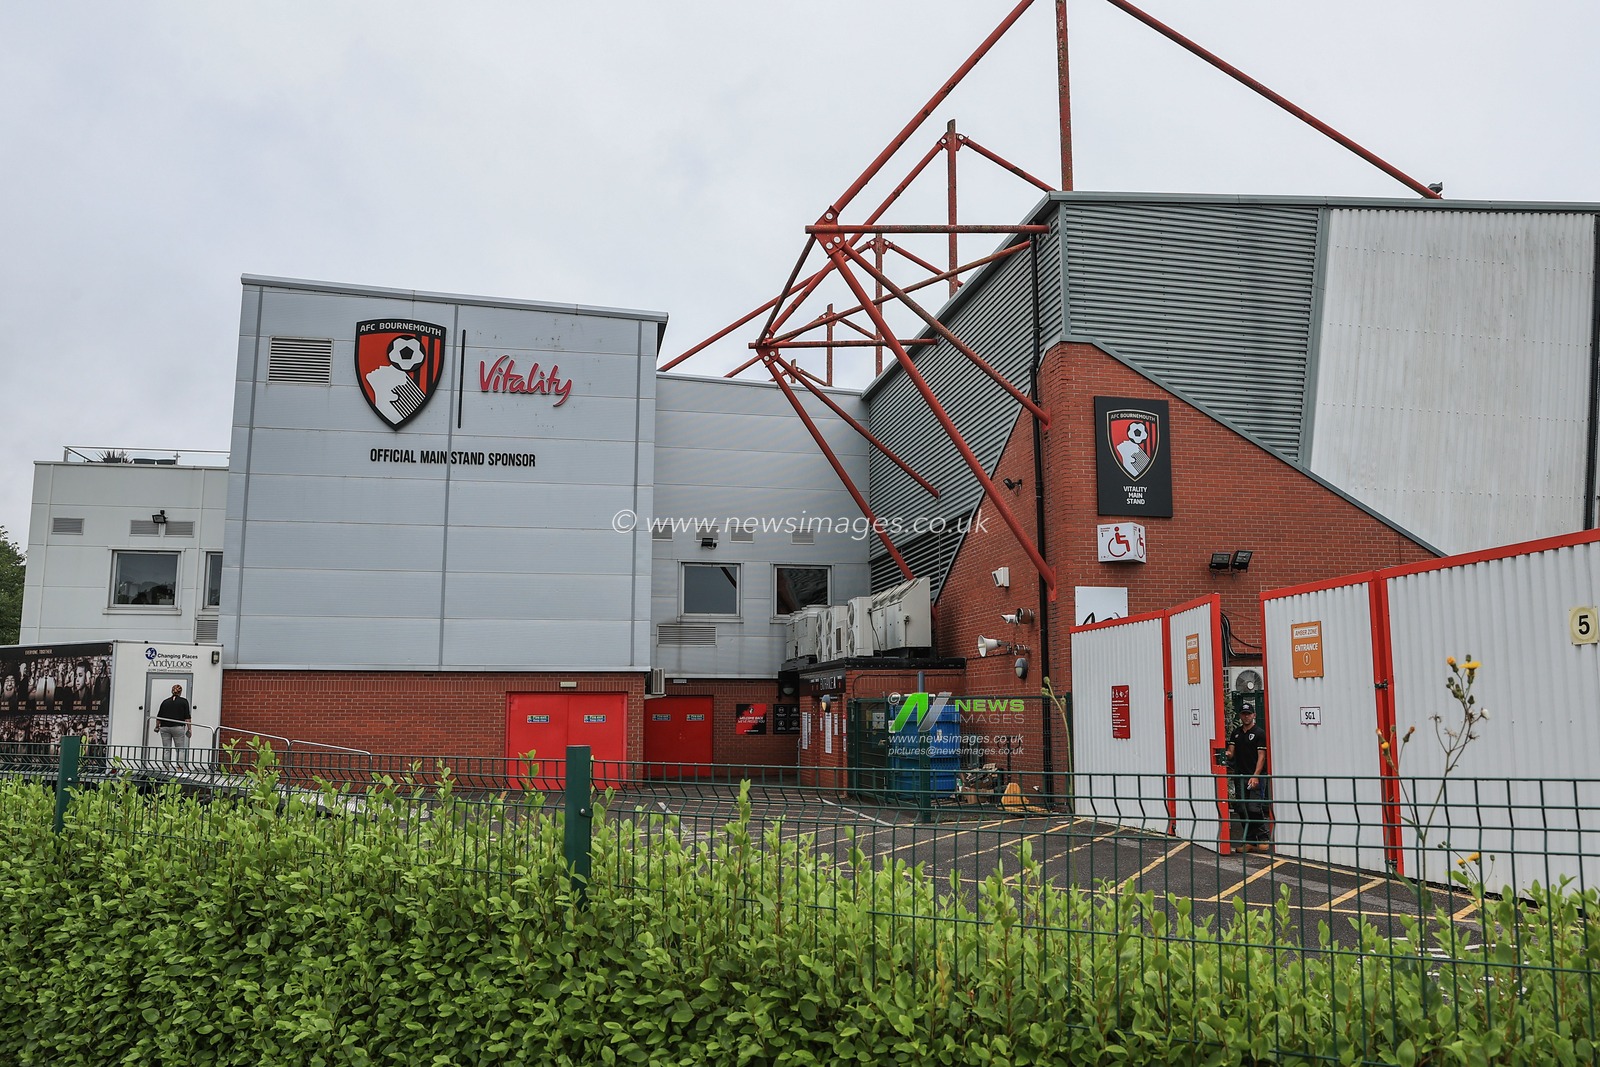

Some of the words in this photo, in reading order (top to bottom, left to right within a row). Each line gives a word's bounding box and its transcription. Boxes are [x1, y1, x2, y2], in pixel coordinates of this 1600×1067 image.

[360, 323, 375, 332] AFC
[379, 322, 442, 336] BOURNEMOUTH
[480, 355, 572, 407] Vitality
[1120, 412, 1156, 421] BOURNEMOUTH
[370, 448, 416, 463] OFFICIAL
[420, 450, 447, 464] MAIN
[450, 451, 485, 465] STAND
[488, 452, 536, 467] SPONSOR
[1578, 614, 1590, 634] 5
[1295, 643, 1318, 652] ENTRANCE
[1305, 712, 1316, 720] SG1
